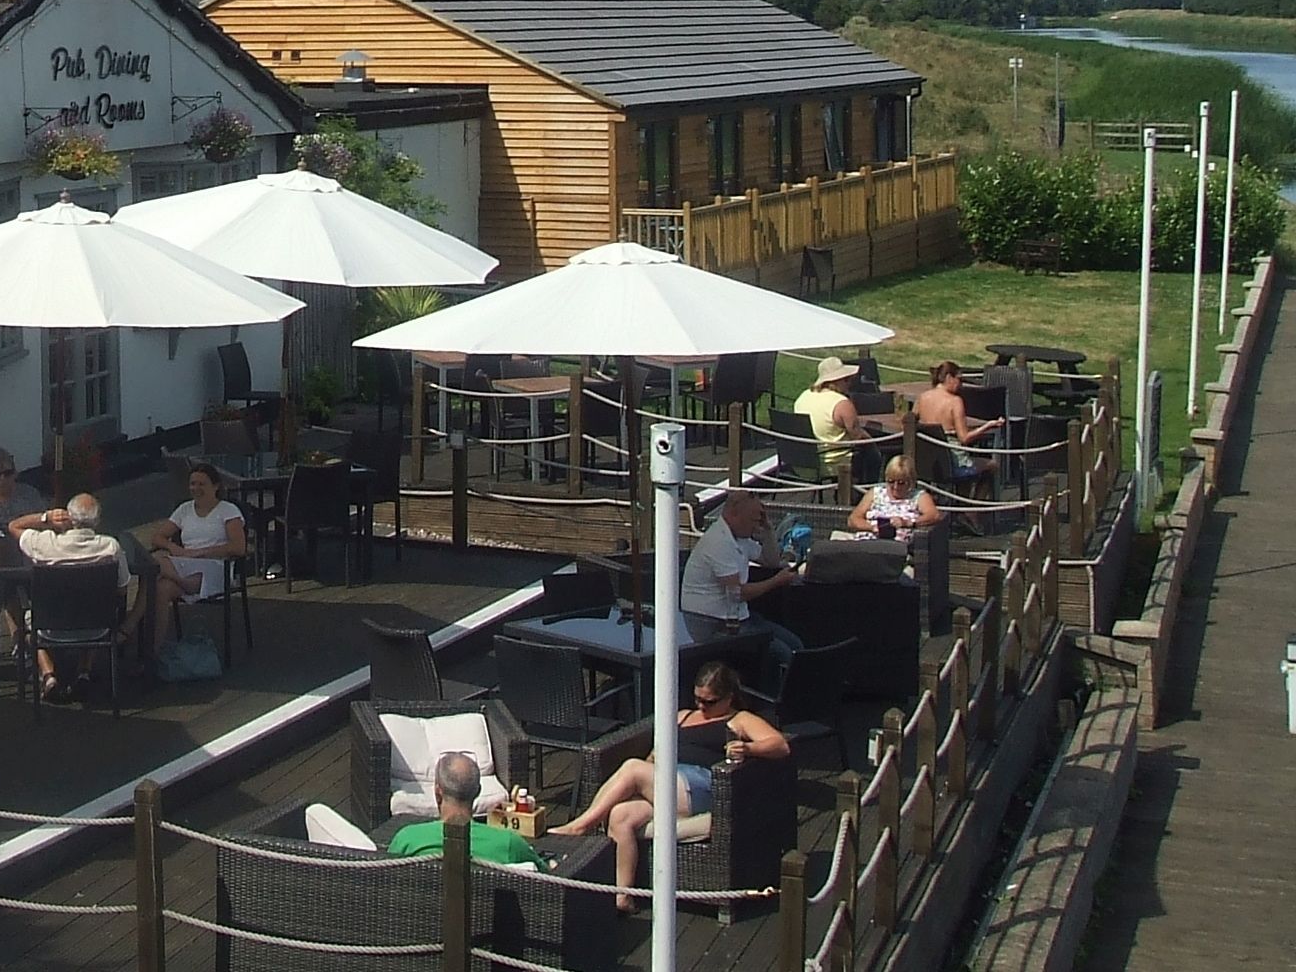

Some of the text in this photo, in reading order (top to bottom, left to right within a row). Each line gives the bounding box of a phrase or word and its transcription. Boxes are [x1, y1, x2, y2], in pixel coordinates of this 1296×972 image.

[95, 45, 151, 82] Dining
[59, 93, 146, 129] and Rooms
